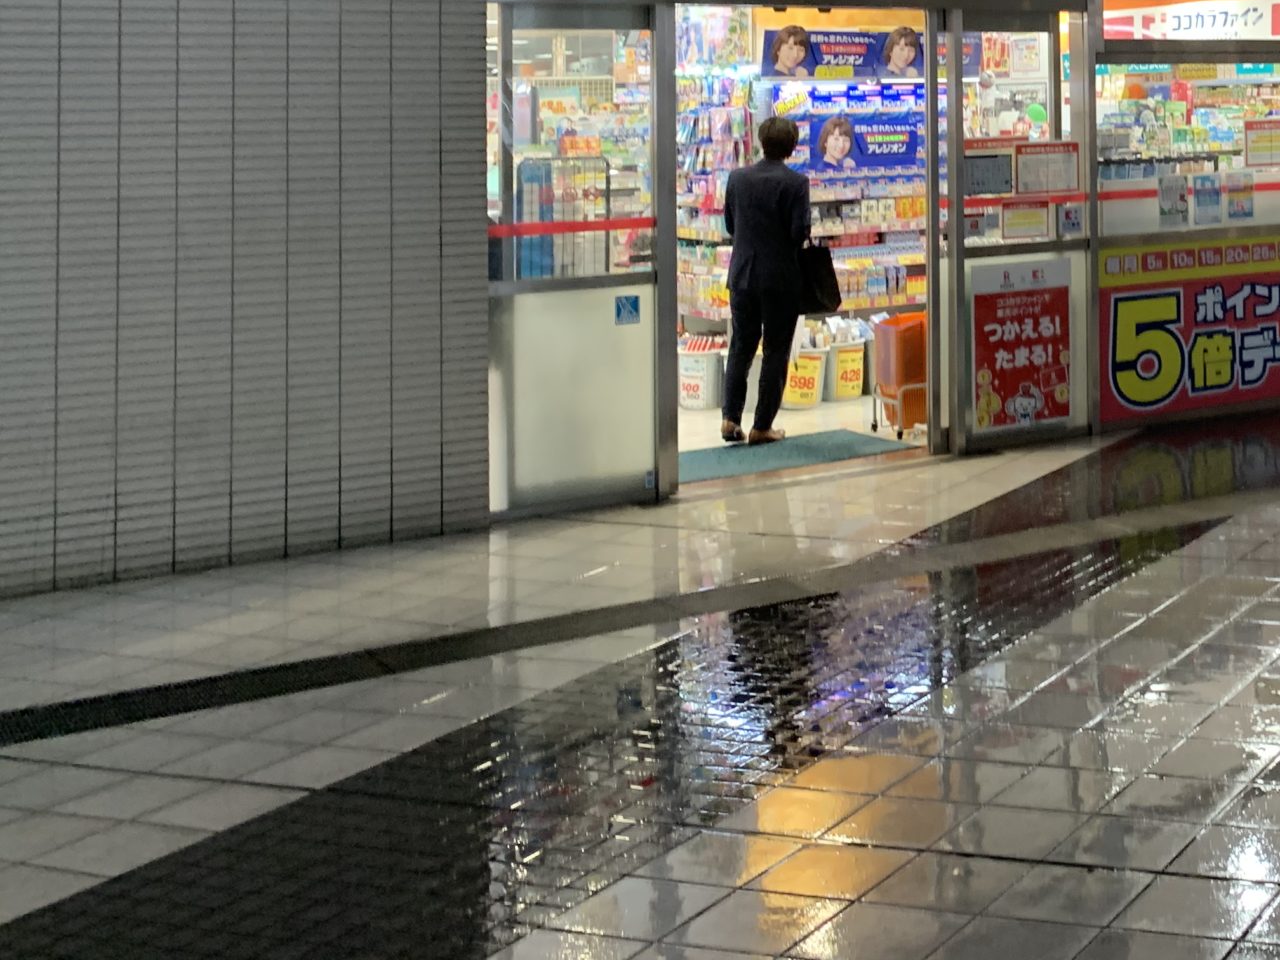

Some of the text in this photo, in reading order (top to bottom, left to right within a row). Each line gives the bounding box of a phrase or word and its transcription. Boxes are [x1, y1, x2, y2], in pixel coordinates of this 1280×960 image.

[1171, 6, 1264, 31] ココカラファイン
[789, 375, 815, 390] 598
